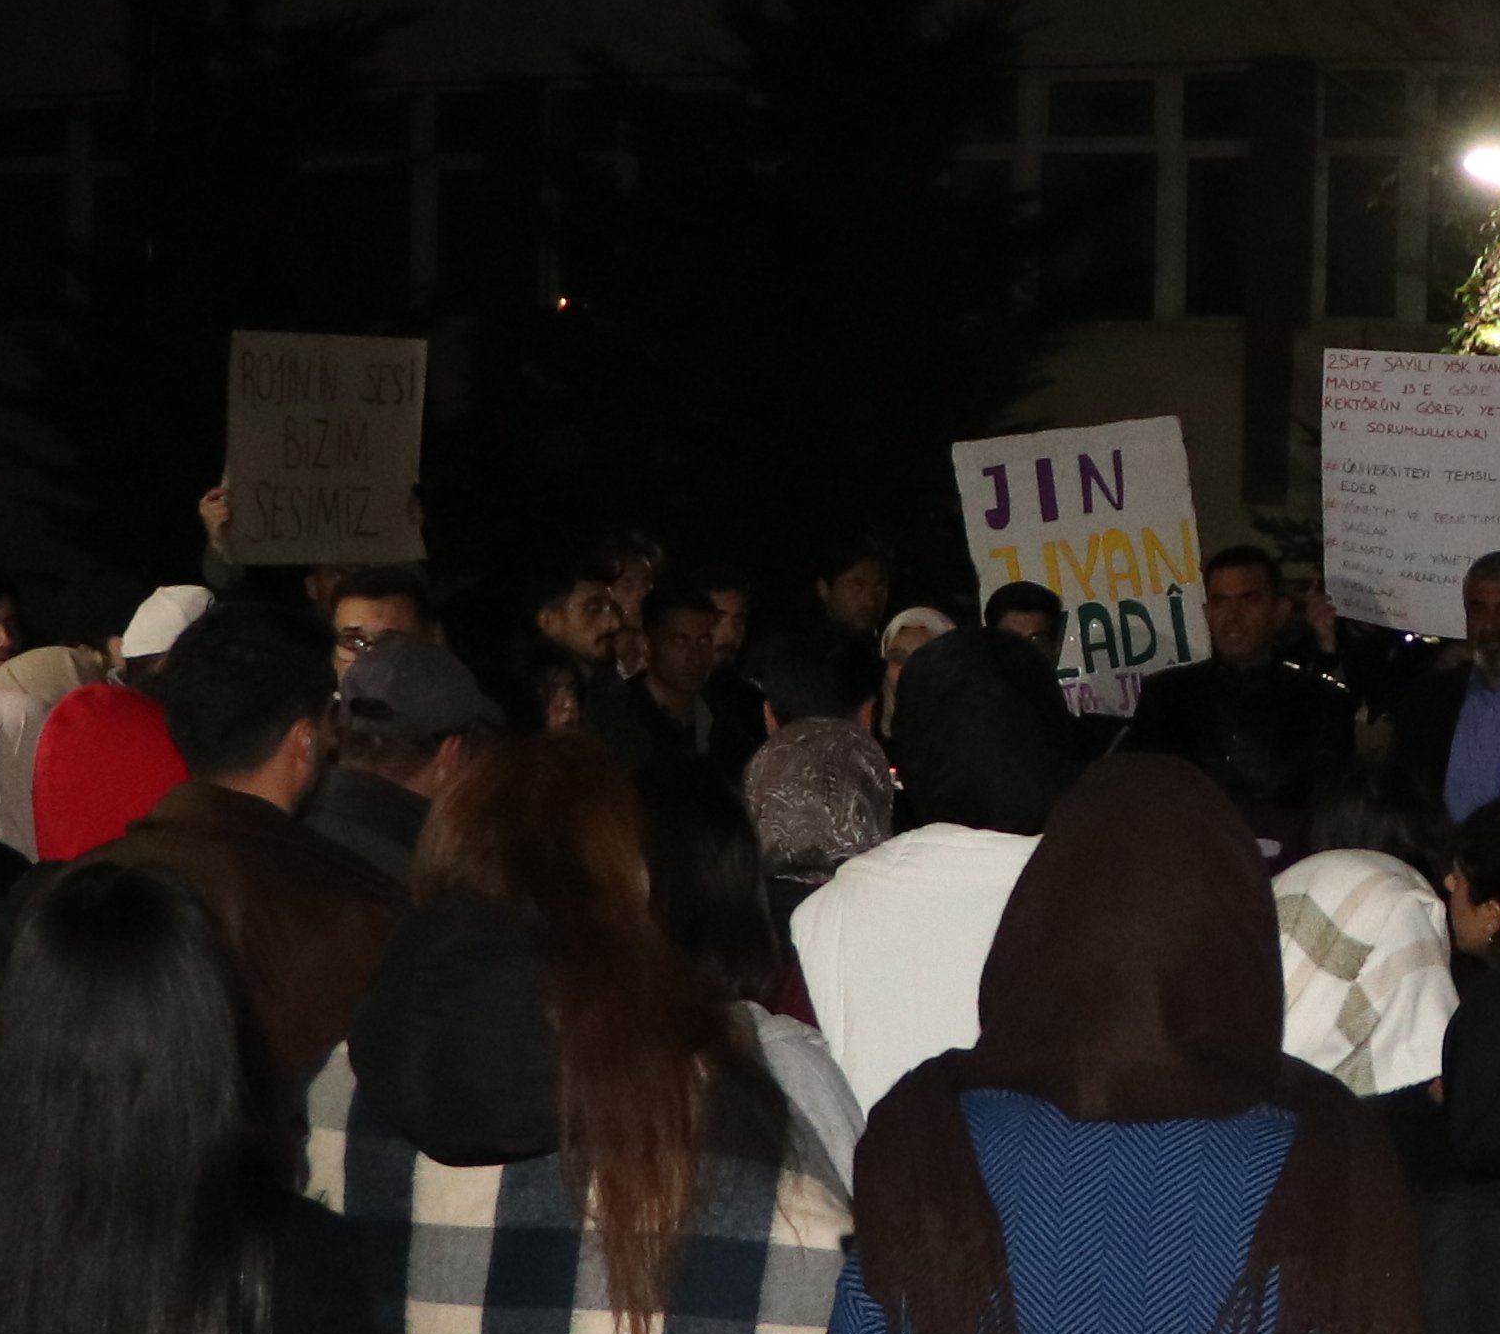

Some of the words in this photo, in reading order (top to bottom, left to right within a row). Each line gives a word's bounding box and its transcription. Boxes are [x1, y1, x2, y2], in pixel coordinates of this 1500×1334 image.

[1325, 377, 1382, 393] MADDE
[1323, 396, 1400, 412] REKTÖRÜN
[1331, 421, 1348, 431] VE
[982, 449, 1124, 530] JIN
[1341, 481, 1378, 496] EDER
[1056, 582, 1192, 680] ZADÎ
